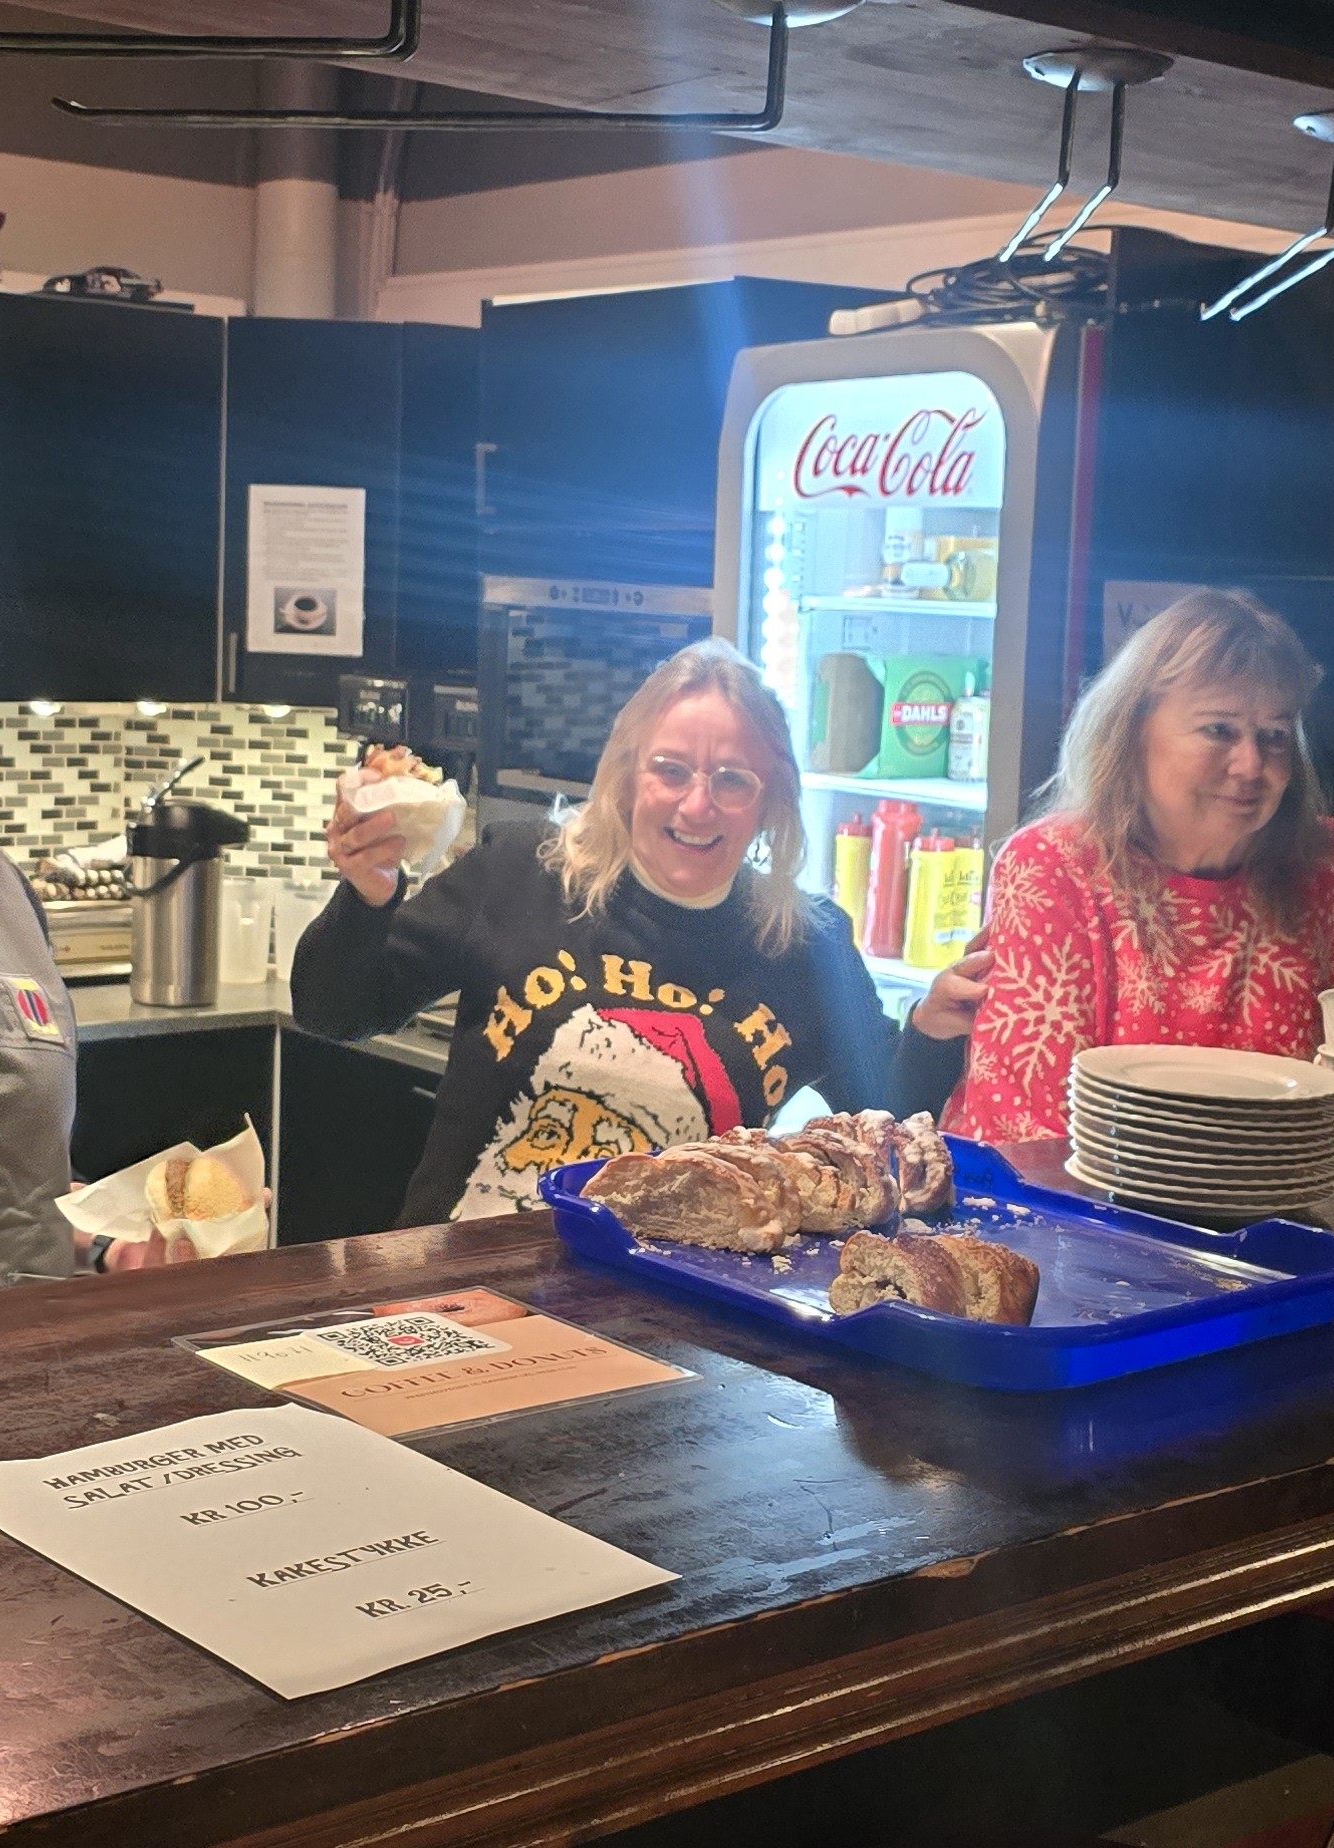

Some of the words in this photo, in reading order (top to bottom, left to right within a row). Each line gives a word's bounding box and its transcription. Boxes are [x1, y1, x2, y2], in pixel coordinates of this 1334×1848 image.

[794, 407, 989, 498] Coca-Cola
[901, 704, 948, 723] DAHLS
[733, 1002, 792, 1127] Ho
[341, 1370, 461, 1398] COFFEE
[489, 1346, 608, 1371] DONUTS
[42, 1448, 206, 1490] HAMBURGER
[203, 1434, 265, 1454] MED
[63, 1476, 154, 1510] SALAT
[179, 1509, 228, 1526] KR
[246, 1530, 439, 1588] KAKESTYKKE
[355, 1598, 412, 1618] KR.
